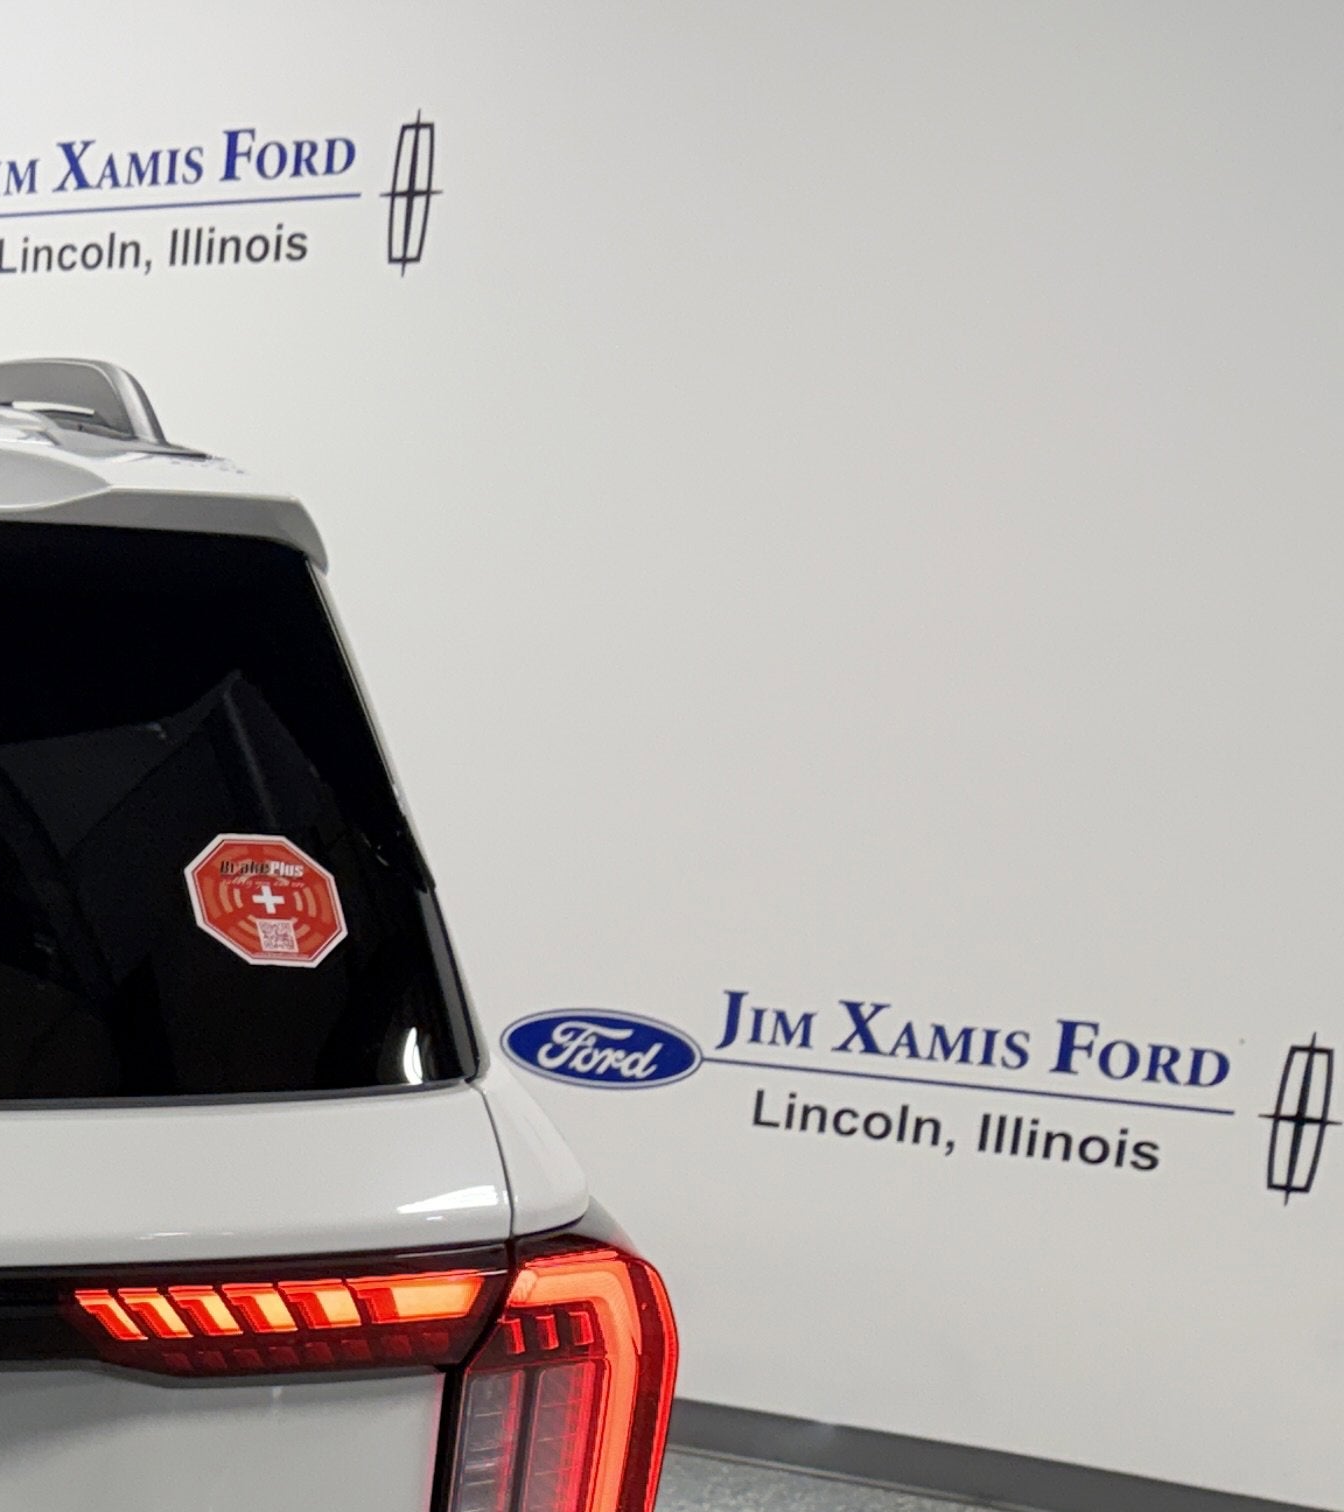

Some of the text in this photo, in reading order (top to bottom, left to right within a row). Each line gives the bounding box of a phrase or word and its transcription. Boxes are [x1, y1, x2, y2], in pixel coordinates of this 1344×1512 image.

[52, 139, 204, 192] XAMIS
[219, 128, 357, 183] FORD
[168, 223, 308, 267] Illinois
[537, 1020, 659, 1081] Ford
[715, 989, 1232, 1090] JIM XAMIS FORD
[751, 1088, 1160, 1171] Lincoln, Illinois
